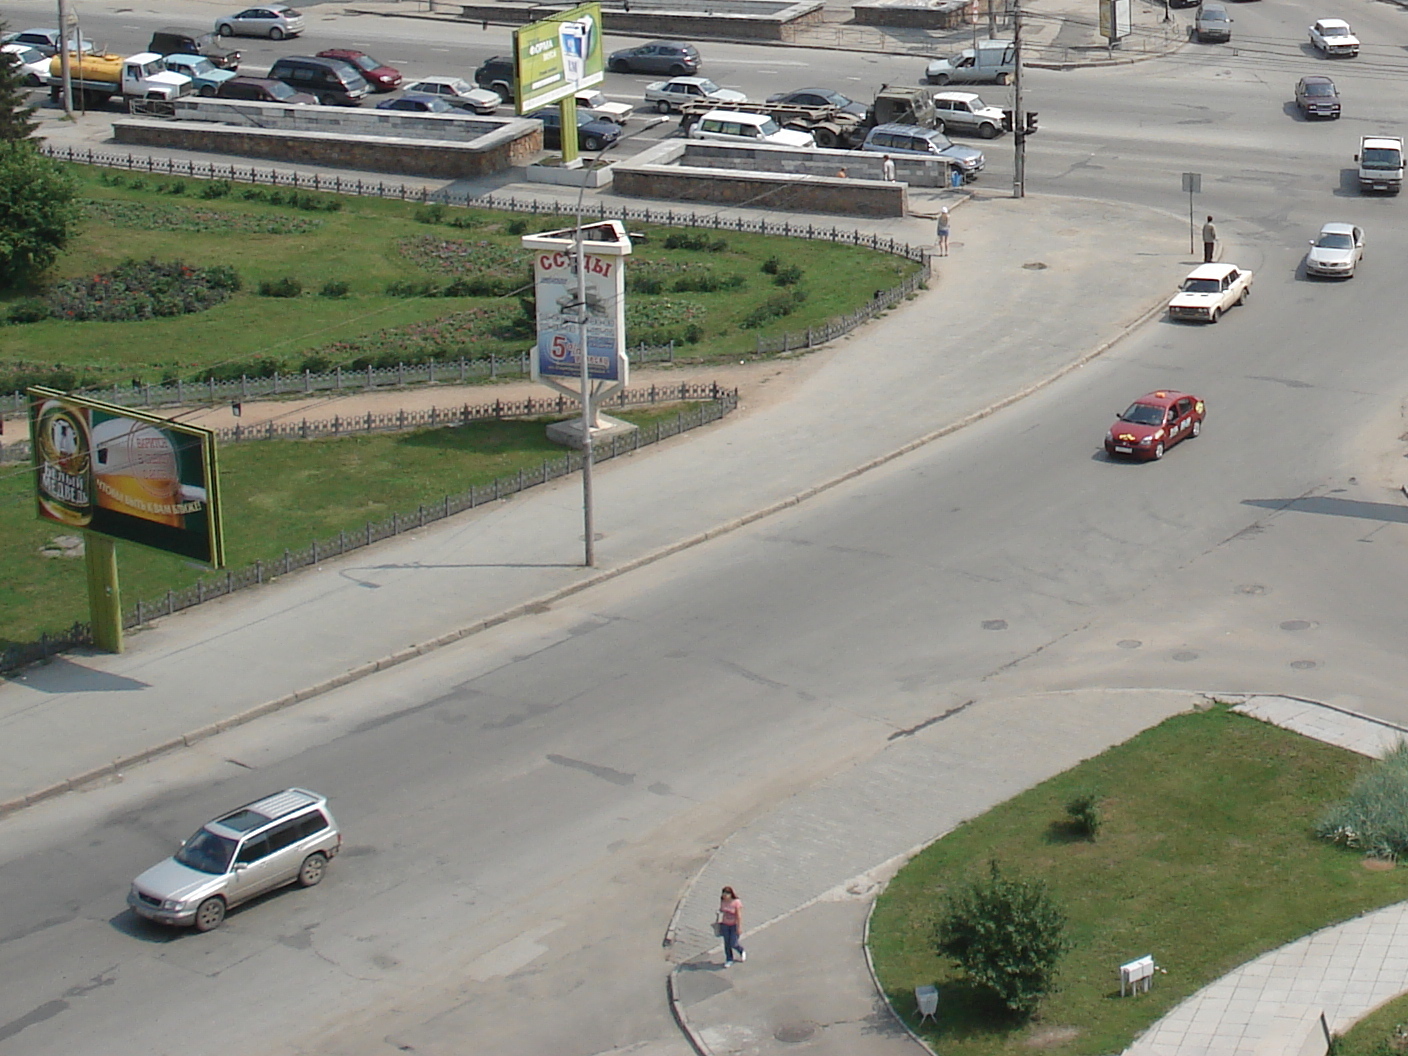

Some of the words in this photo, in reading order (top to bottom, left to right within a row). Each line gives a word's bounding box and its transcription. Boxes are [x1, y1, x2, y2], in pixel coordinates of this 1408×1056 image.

[42, 473, 88, 504] МЕДВЕДЬ
[44, 461, 84, 490] БЕЛЫЙ
[154, 504, 172, 515] ВАМ
